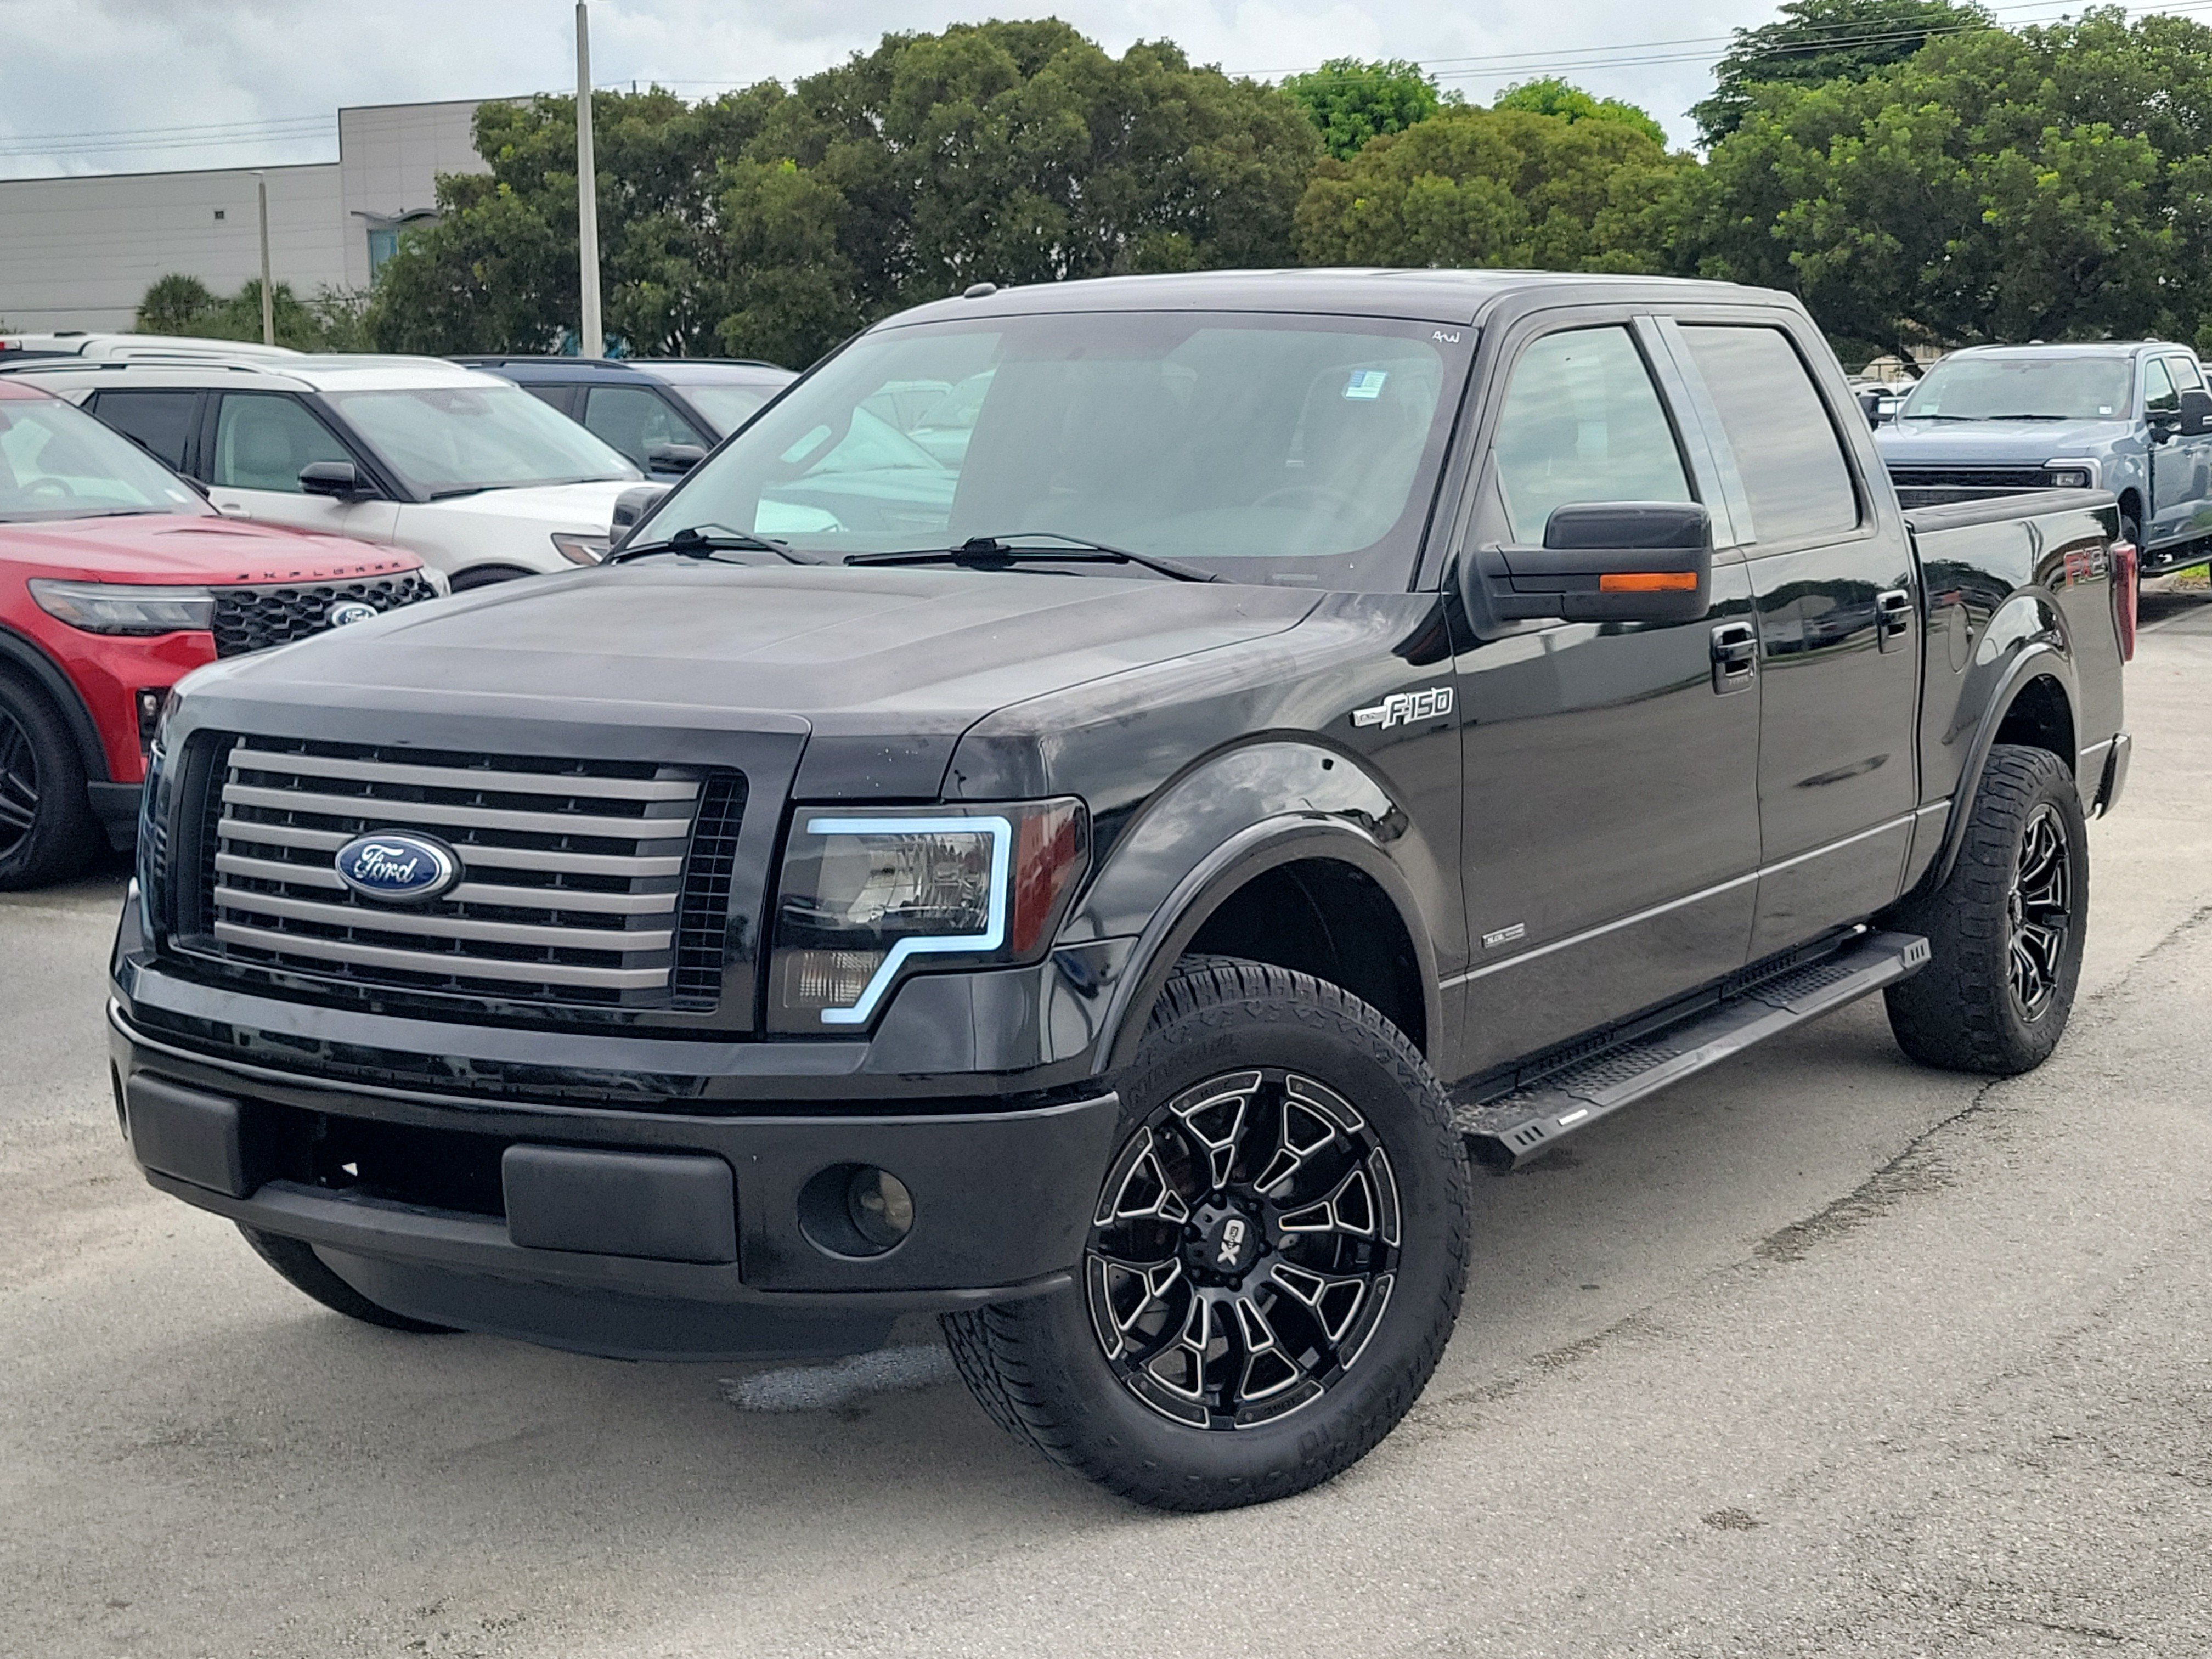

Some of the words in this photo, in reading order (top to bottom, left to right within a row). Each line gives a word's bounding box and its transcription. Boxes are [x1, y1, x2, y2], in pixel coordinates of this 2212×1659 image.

[236, 561, 400, 580] EXPLORER
[354, 844, 417, 884] Ford
[1217, 1218, 1245, 1266] XD
